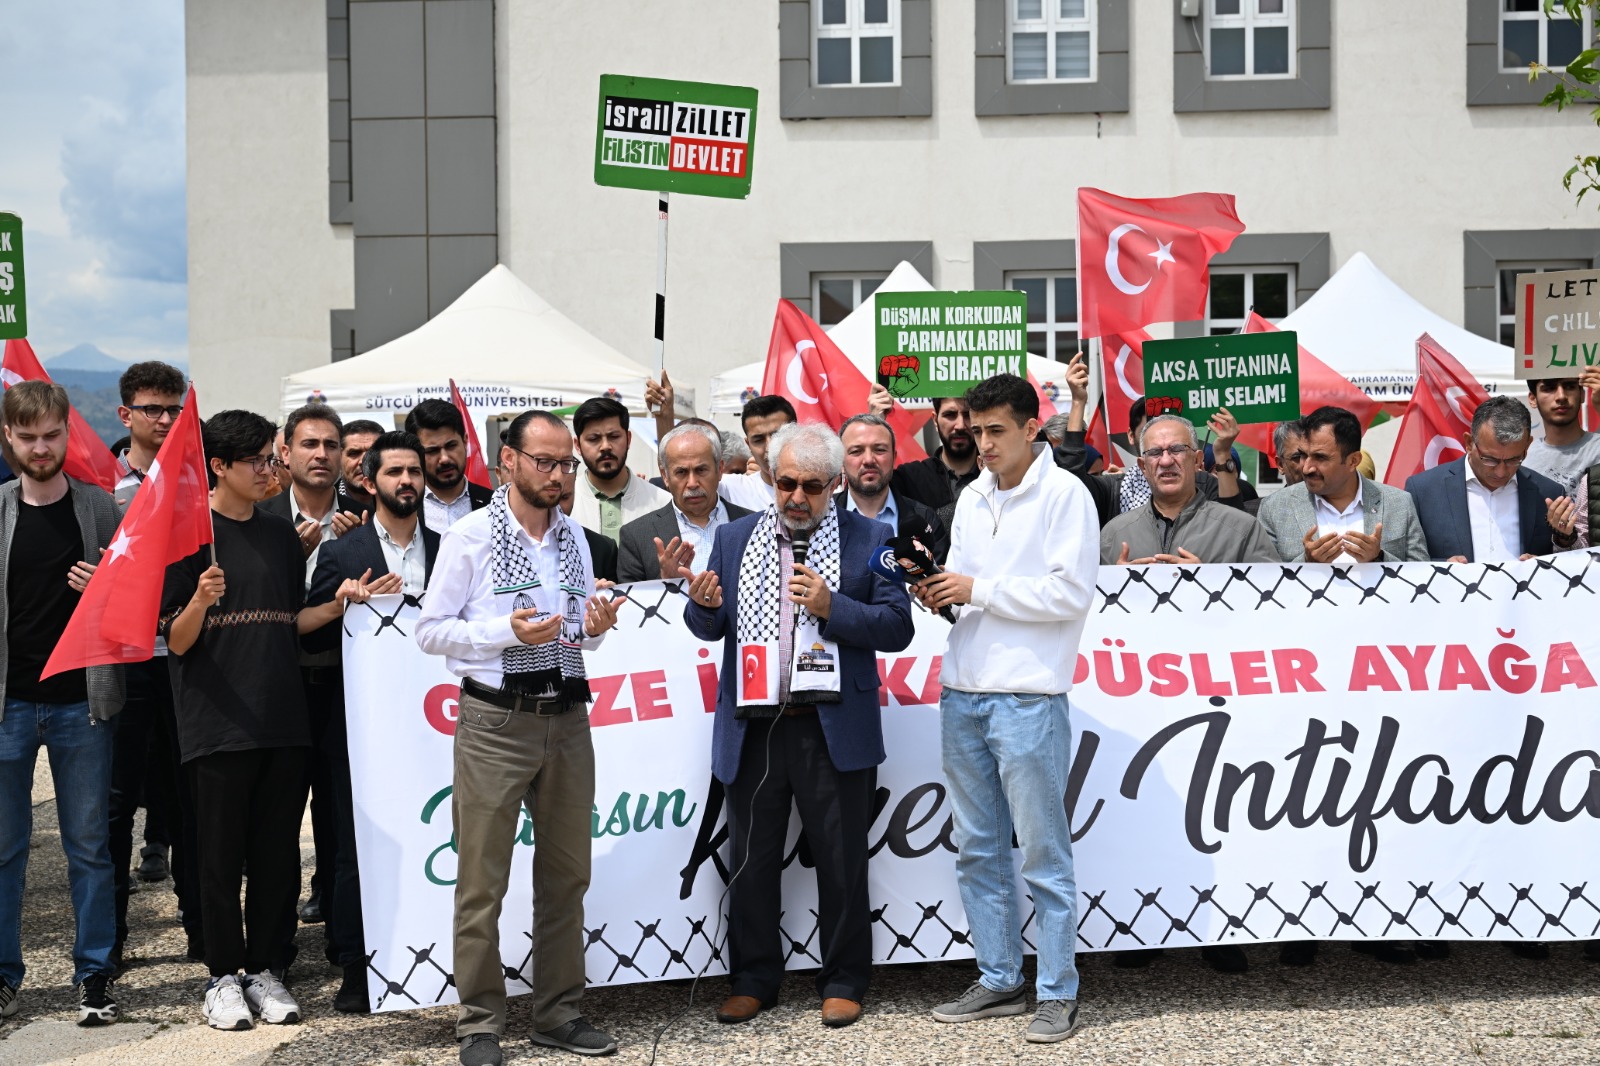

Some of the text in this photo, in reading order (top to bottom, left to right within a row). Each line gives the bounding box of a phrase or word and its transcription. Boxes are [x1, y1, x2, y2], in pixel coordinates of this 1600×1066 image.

[604, 99, 670, 132] israil
[672, 142, 744, 174] DEVLET
[1545, 278, 1598, 300] LET
[944, 305, 1022, 326] KORKUDAN
[1544, 311, 1600, 333] CHIL
[897, 329, 1022, 353] PARMAKLARINI
[1150, 352, 1292, 383] AKSA TUFANINA
[1546, 342, 1600, 369] LIV
[366, 395, 412, 409] SÜTÇÜ
[1188, 385, 1220, 409] BİN
[1224, 383, 1287, 407] SELAM!
[1347, 627, 1599, 695] AYAĞA
